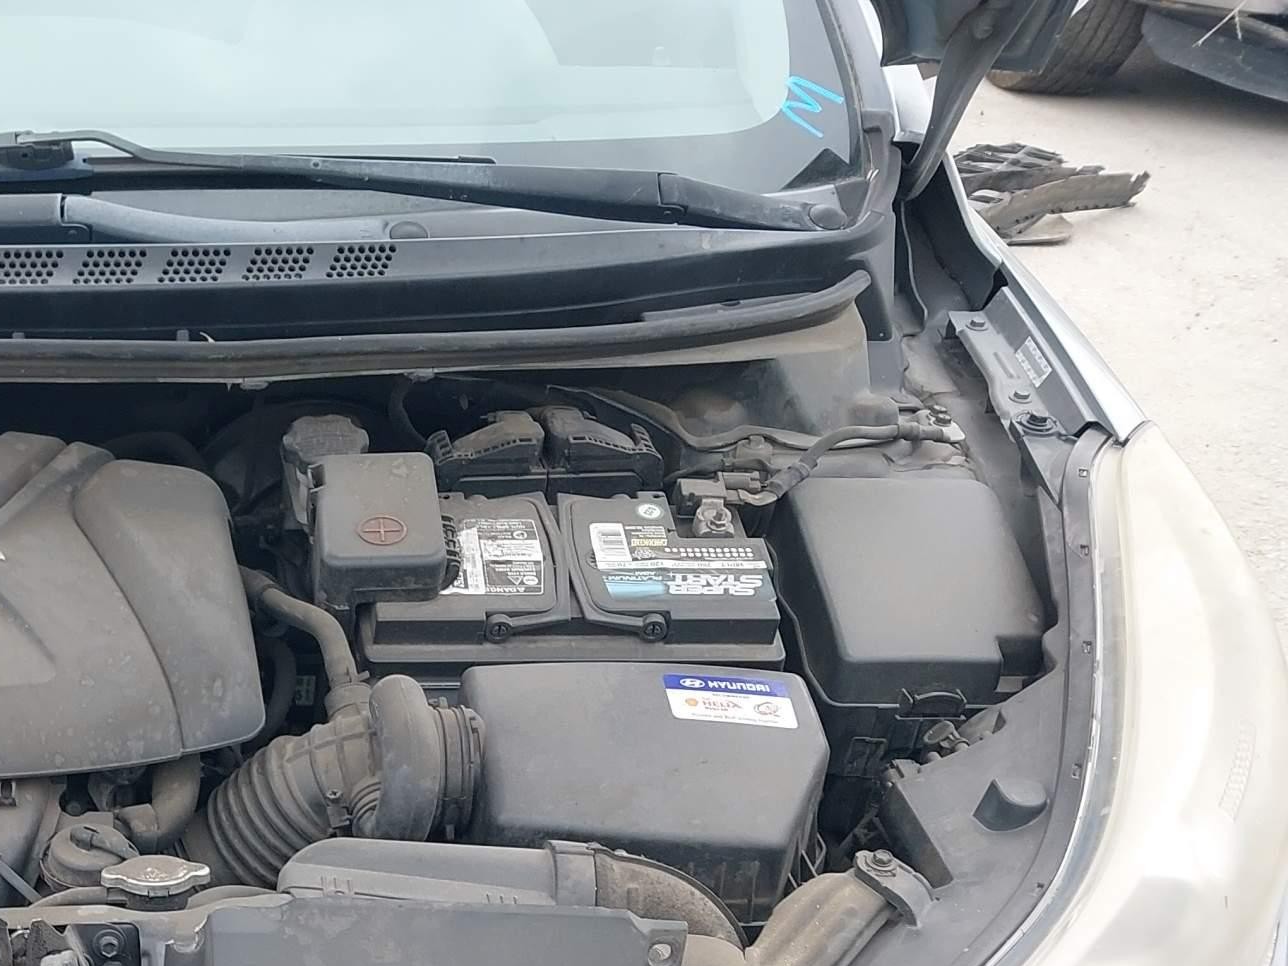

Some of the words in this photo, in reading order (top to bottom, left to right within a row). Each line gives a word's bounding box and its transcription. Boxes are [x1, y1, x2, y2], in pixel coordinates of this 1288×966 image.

[669, 574, 763, 587] START
[668, 584, 755, 596] SUPER
[708, 680, 770, 692] HYUNDAI
